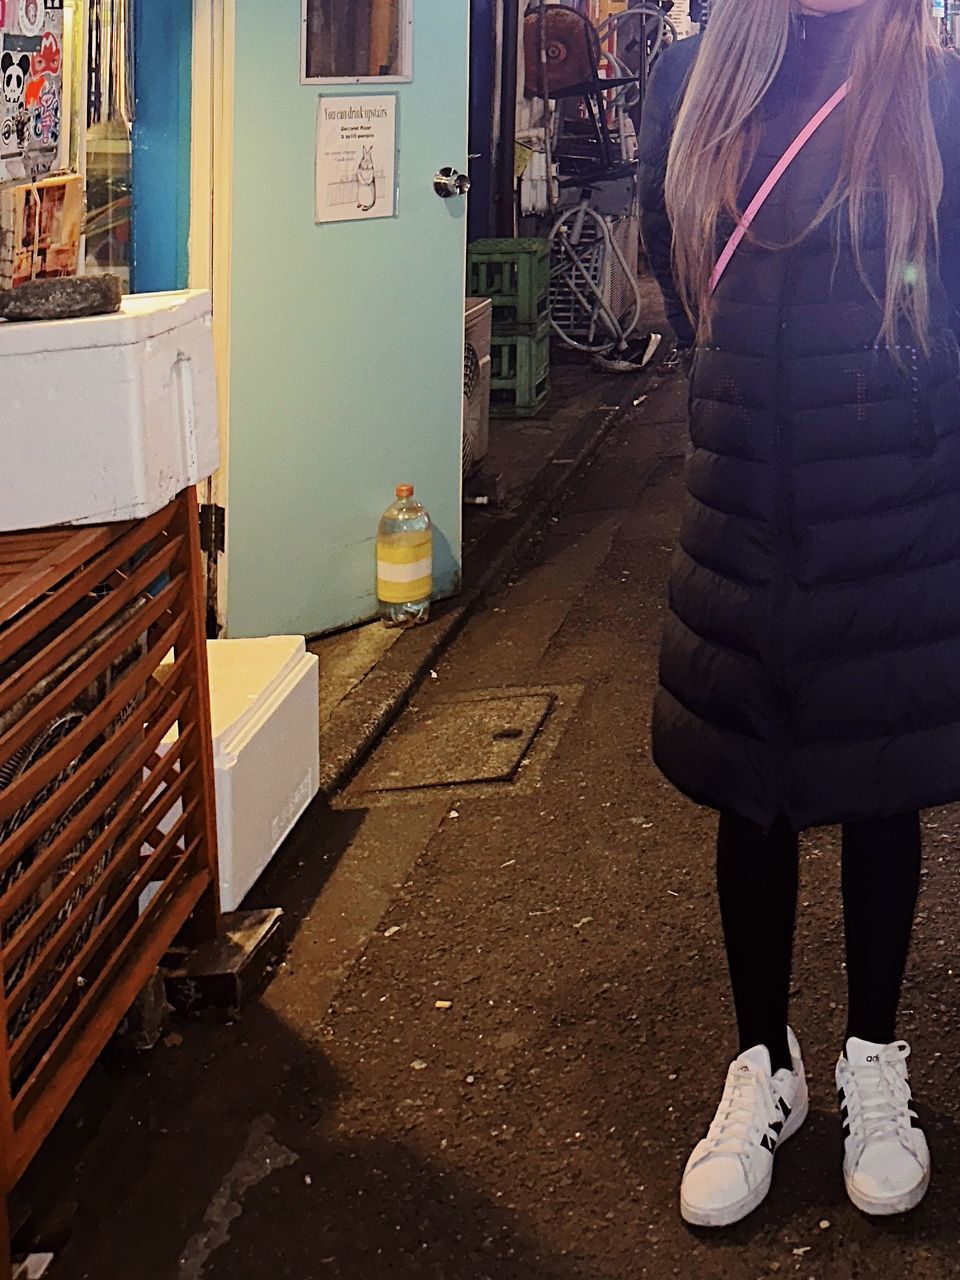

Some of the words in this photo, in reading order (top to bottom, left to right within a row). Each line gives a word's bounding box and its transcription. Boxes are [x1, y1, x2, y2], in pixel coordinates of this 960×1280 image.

[325, 108, 335, 120] You
[337, 110, 346, 119] can
[348, 106, 363, 119] drink
[365, 105, 388, 122] upstairs
